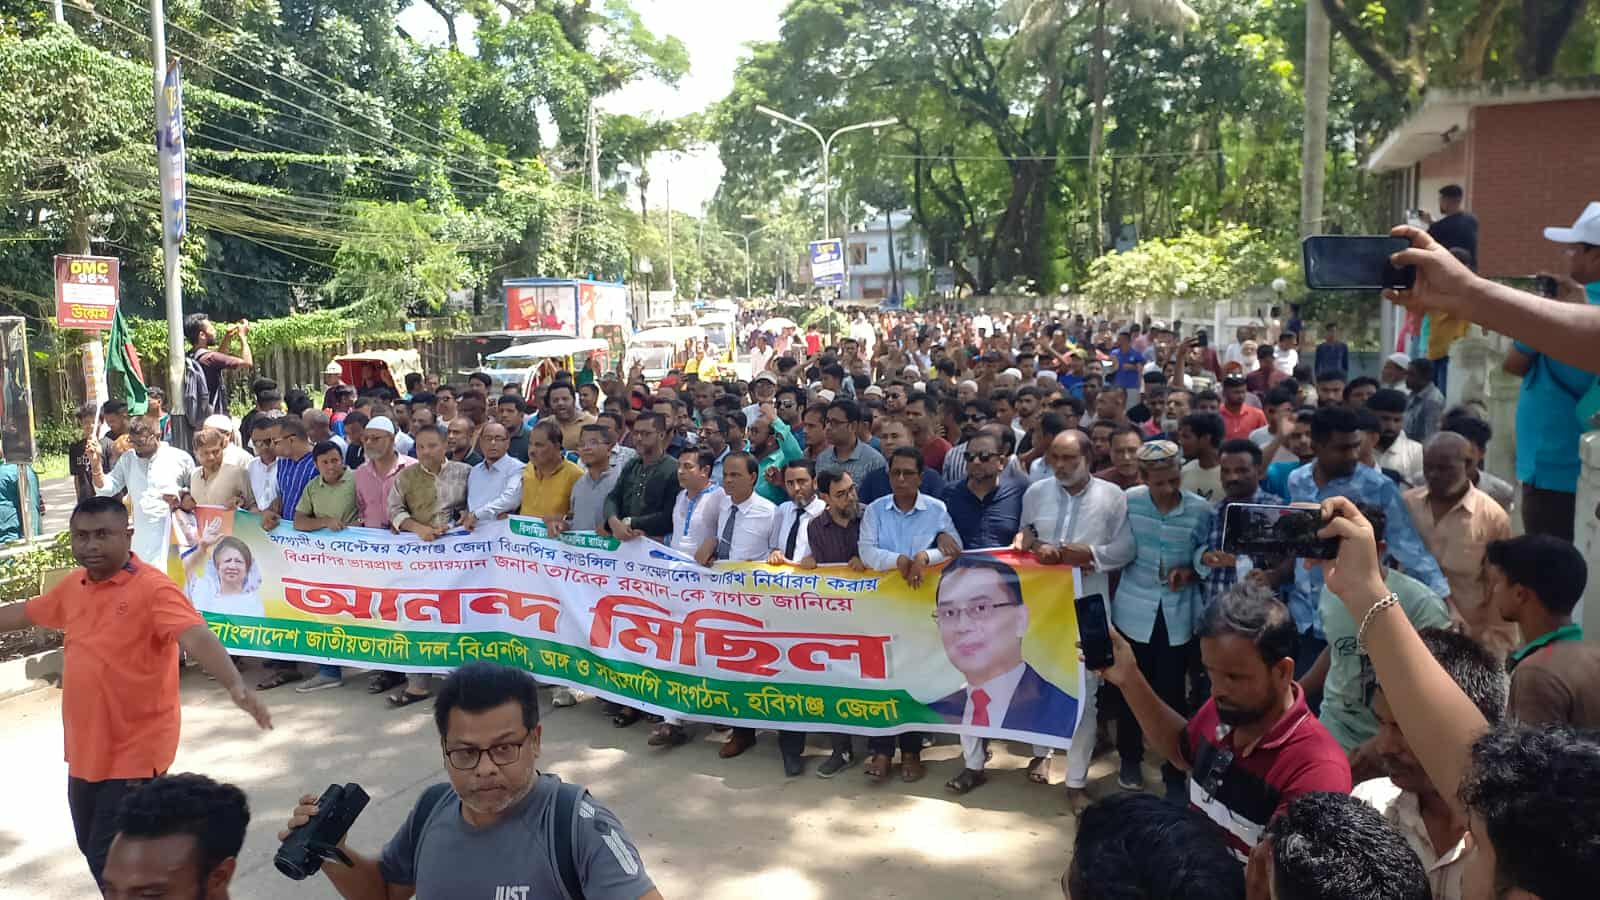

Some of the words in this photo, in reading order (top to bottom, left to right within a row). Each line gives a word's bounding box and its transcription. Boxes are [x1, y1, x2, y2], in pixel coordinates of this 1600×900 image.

[283, 549, 344, 566] বিএনপির
[410, 559, 488, 571] চেয়ারম্যান
[492, 555, 539, 573] জনাব
[543, 564, 610, 587] তারেক
[711, 589, 767, 608] স্বাগত
[771, 591, 854, 612] জানিয়ে
[315, 540, 325, 550] ৬
[397, 542, 446, 554] হবিগঞ্জ
[453, 541, 492, 553] জেলা
[498, 536, 556, 560] বিএনপির
[563, 550, 618, 571] কাউন্সিল
[624, 561, 635, 572] ও
[752, 569, 820, 590] নির্ধারণ
[827, 576, 881, 592] করায়
[281, 577, 560, 634] আনন্দ
[589, 594, 892, 680] মিছিল
[208, 621, 301, 648] বাংলাদেশ
[305, 626, 412, 659] জাতীয়তাবাদী
[540, 649, 570, 673] অঙ্গ
[576, 659, 590, 676] ও
[744, 685, 825, 717] হবিগঞ্জ
[835, 697, 900, 720] জেলা
